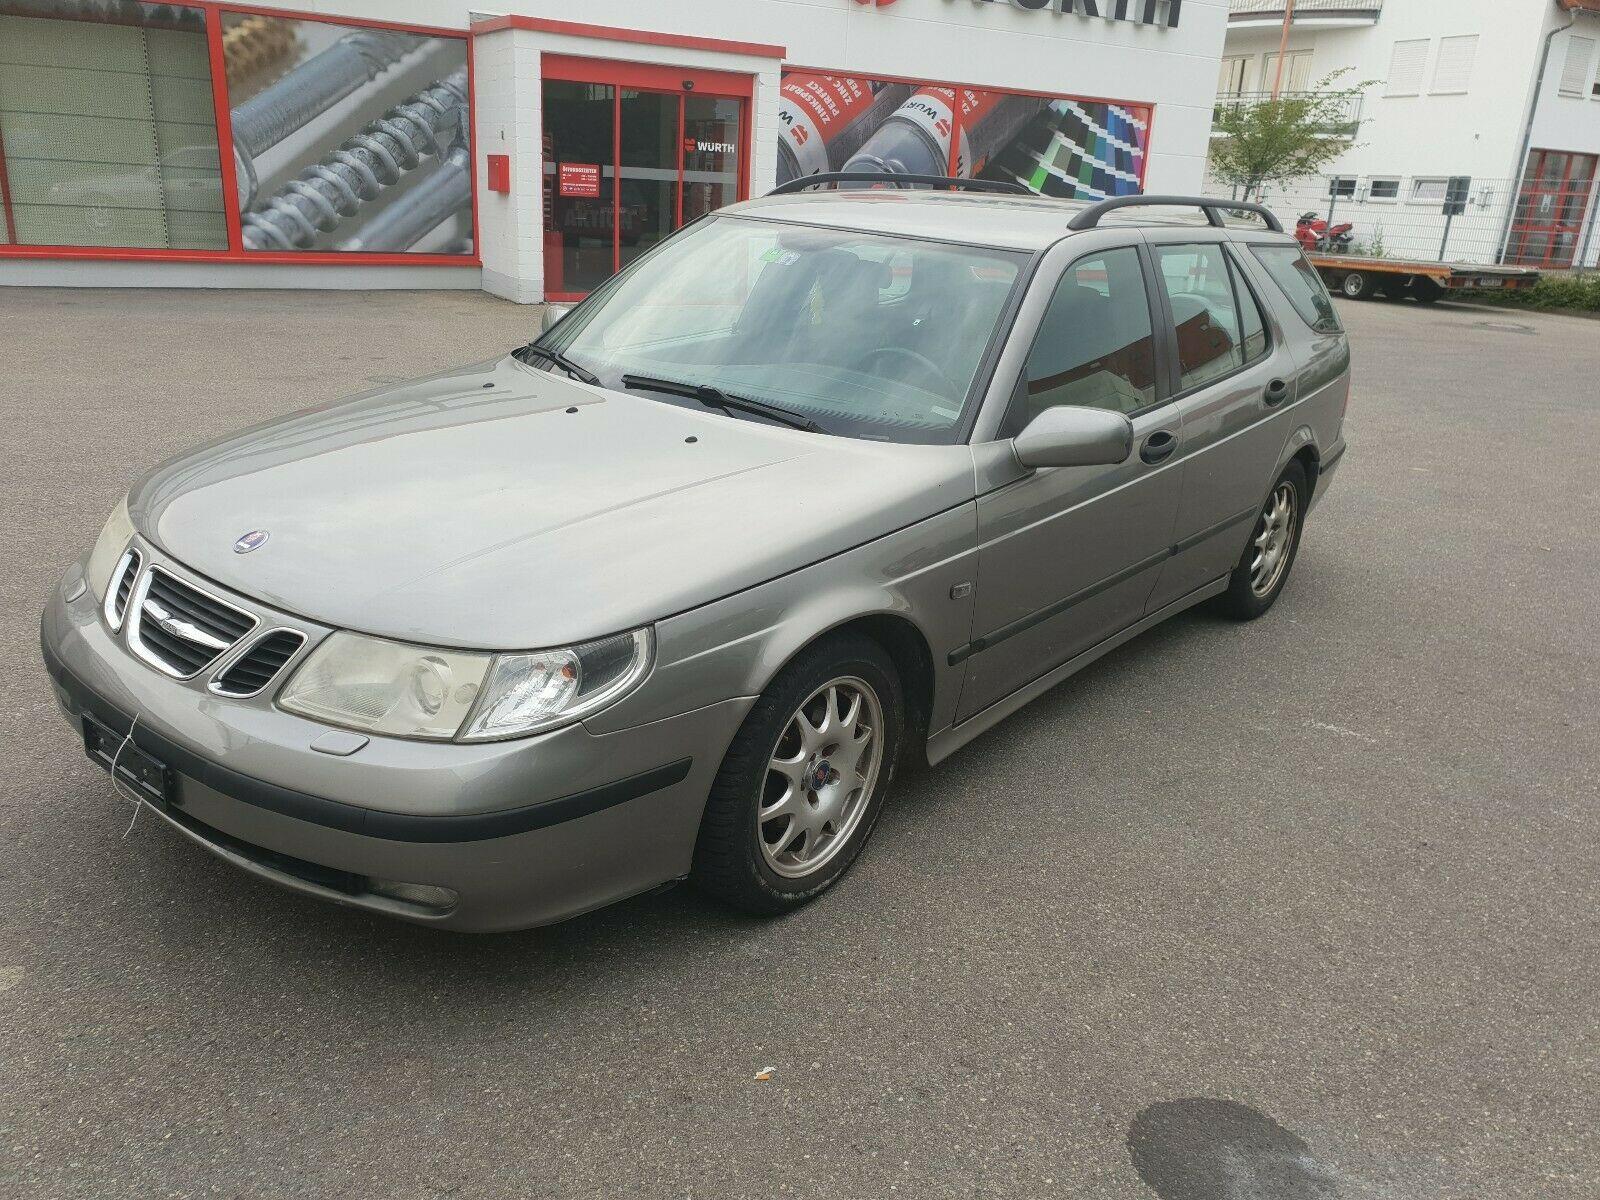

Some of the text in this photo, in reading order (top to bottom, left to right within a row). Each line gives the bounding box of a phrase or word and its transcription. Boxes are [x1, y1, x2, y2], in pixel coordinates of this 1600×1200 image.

[782, 83, 831, 125] ZINKSPRAY
[806, 80, 840, 117] PERFECT
[832, 80, 853, 106] ZINC
[697, 141, 735, 153] WÜRTH
